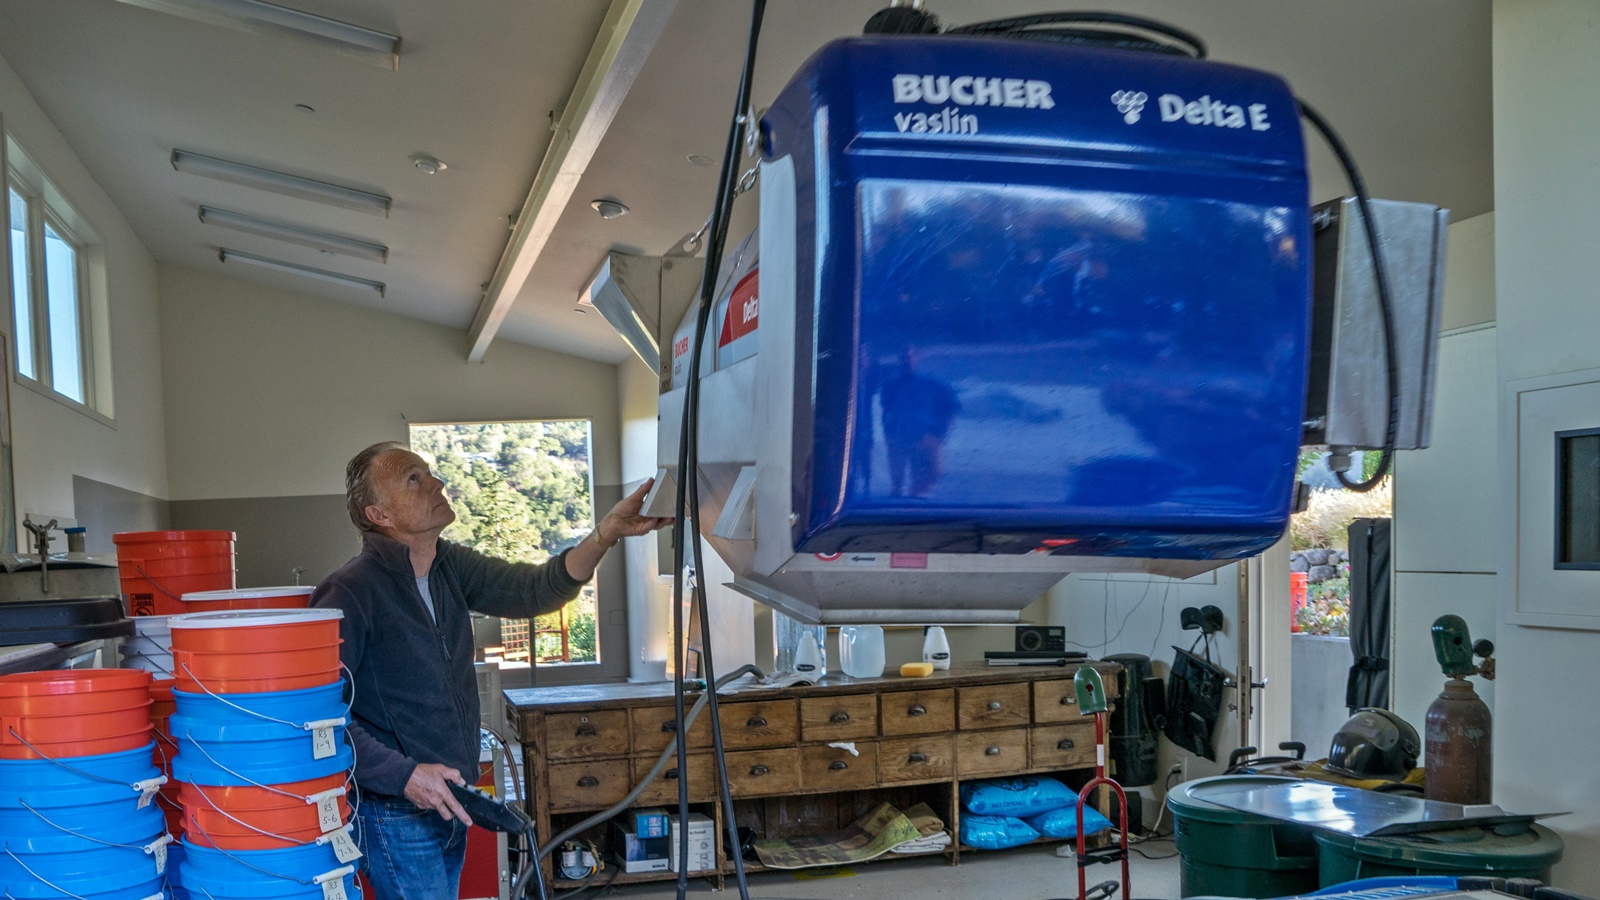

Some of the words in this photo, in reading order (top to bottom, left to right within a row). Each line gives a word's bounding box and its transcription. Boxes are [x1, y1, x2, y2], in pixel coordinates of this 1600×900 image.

[892, 73, 1056, 110] BUCHER
[893, 106, 979, 134] vaslin
[1158, 93, 1246, 130] Delta
[1251, 103, 1271, 132] E
[318, 729, 328, 739] R3
